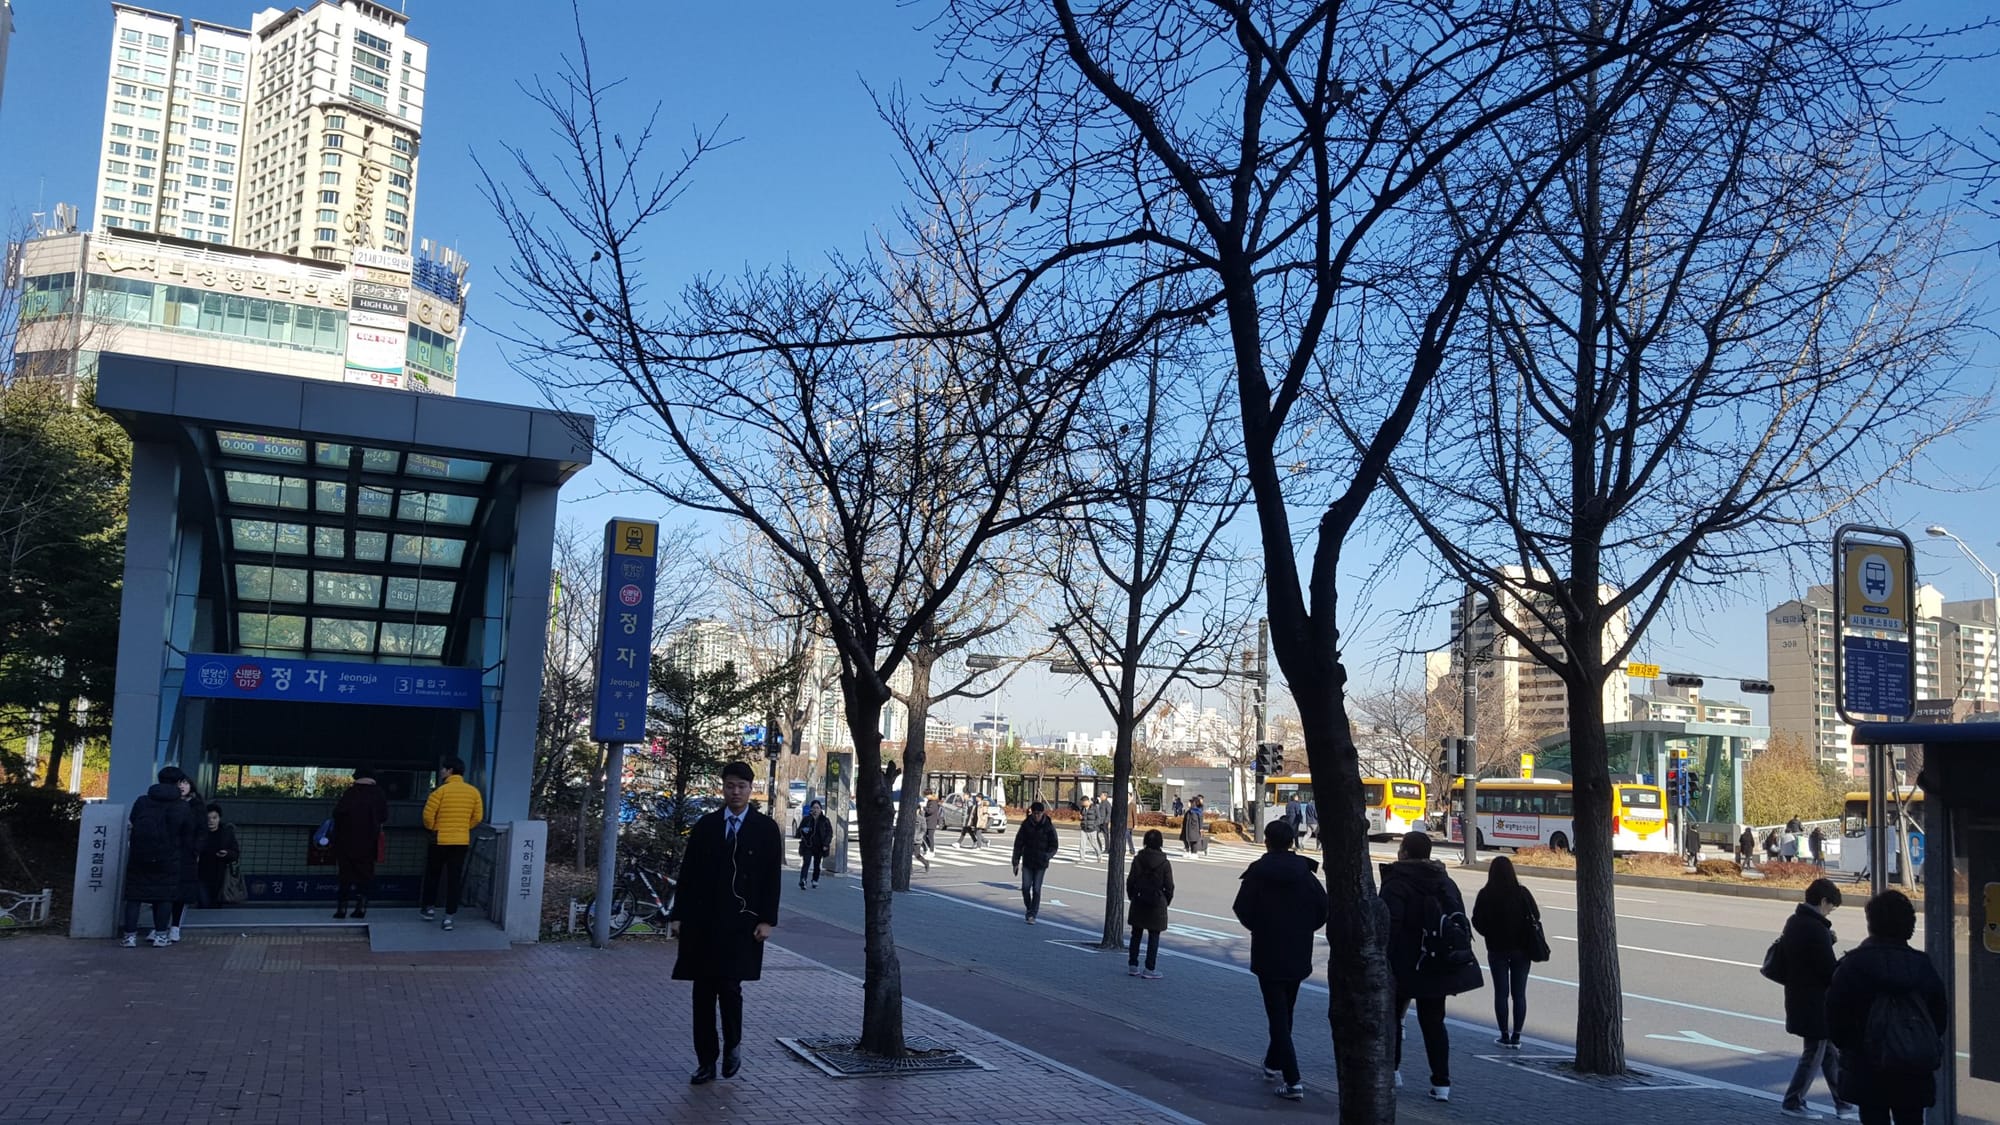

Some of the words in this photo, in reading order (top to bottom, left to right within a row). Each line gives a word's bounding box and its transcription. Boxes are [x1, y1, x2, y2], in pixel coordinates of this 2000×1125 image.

[360, 299, 381, 310] HIGH
[382, 303, 399, 313] BAR
[370, 371, 399, 387] 약국
[263, 444, 303, 457] 50,000
[616, 612, 638, 669] 정자
[201, 668, 227, 679] 분당선
[234, 668, 262, 680] 신분당
[339, 672, 378, 685] Jeongja
[203, 678, 223, 686] K230
[239, 679, 257, 688] D12
[398, 679, 409, 692] 3
[609, 678, 640, 689] Jeongja
[617, 718, 626, 731] 3
[88, 825, 107, 893] 지하철입구
[519, 839, 535, 900] 지하철입구
